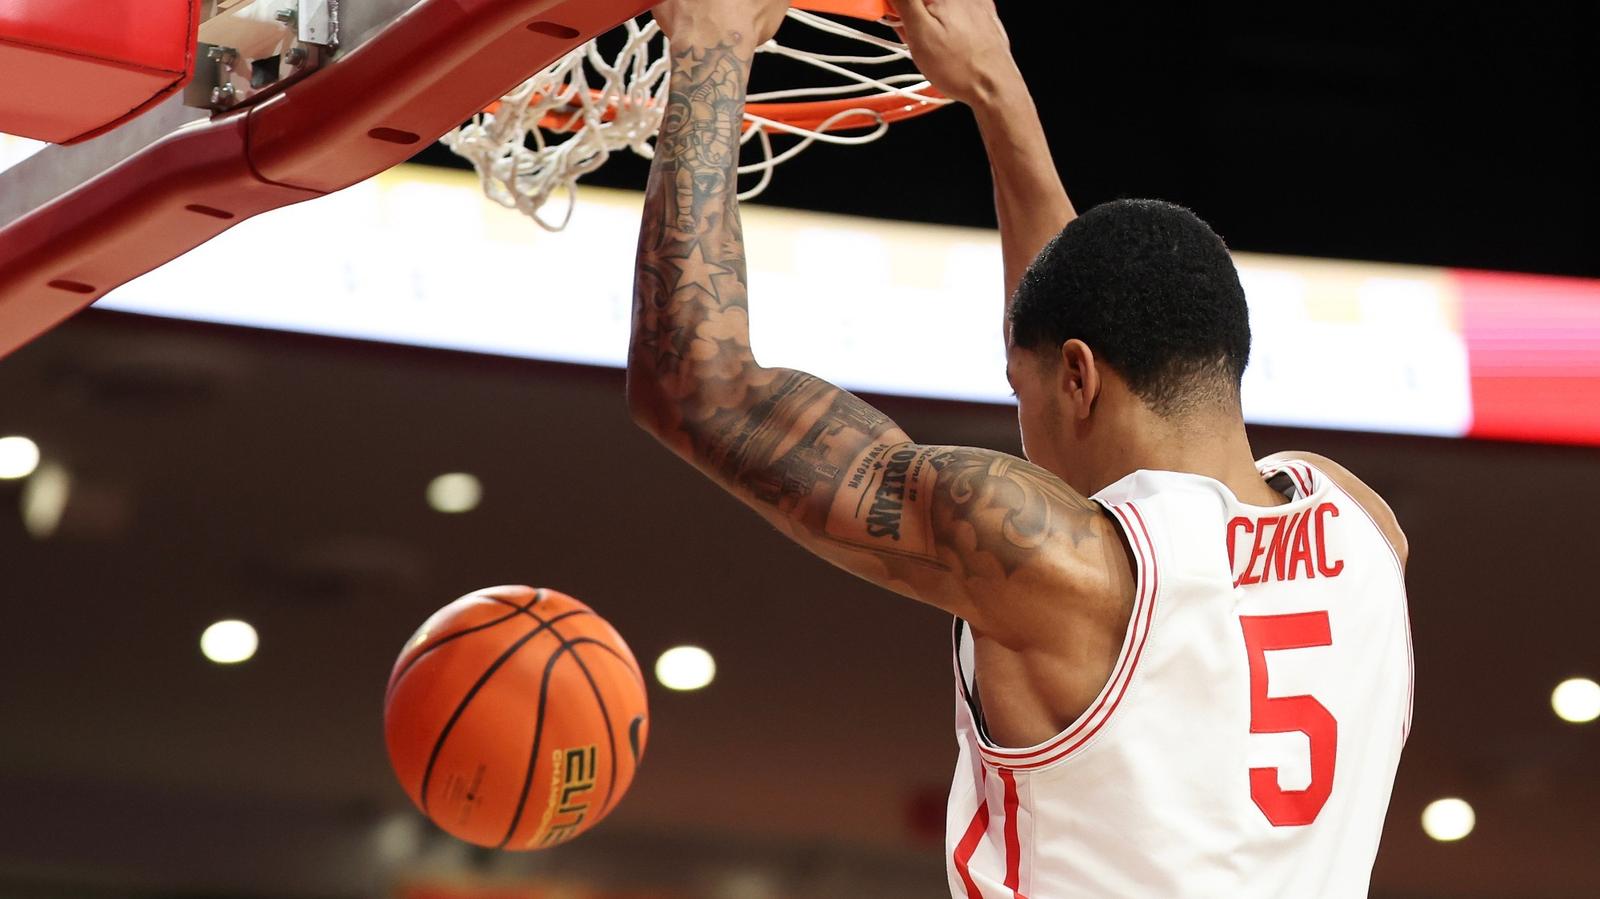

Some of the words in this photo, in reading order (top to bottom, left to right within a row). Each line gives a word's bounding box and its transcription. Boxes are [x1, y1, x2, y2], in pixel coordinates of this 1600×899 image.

[848, 444, 889, 489] DOWNTOWN
[866, 450, 917, 541] ORLEANS
[1226, 502, 1344, 589] CENAC
[1239, 610, 1338, 827] 5
